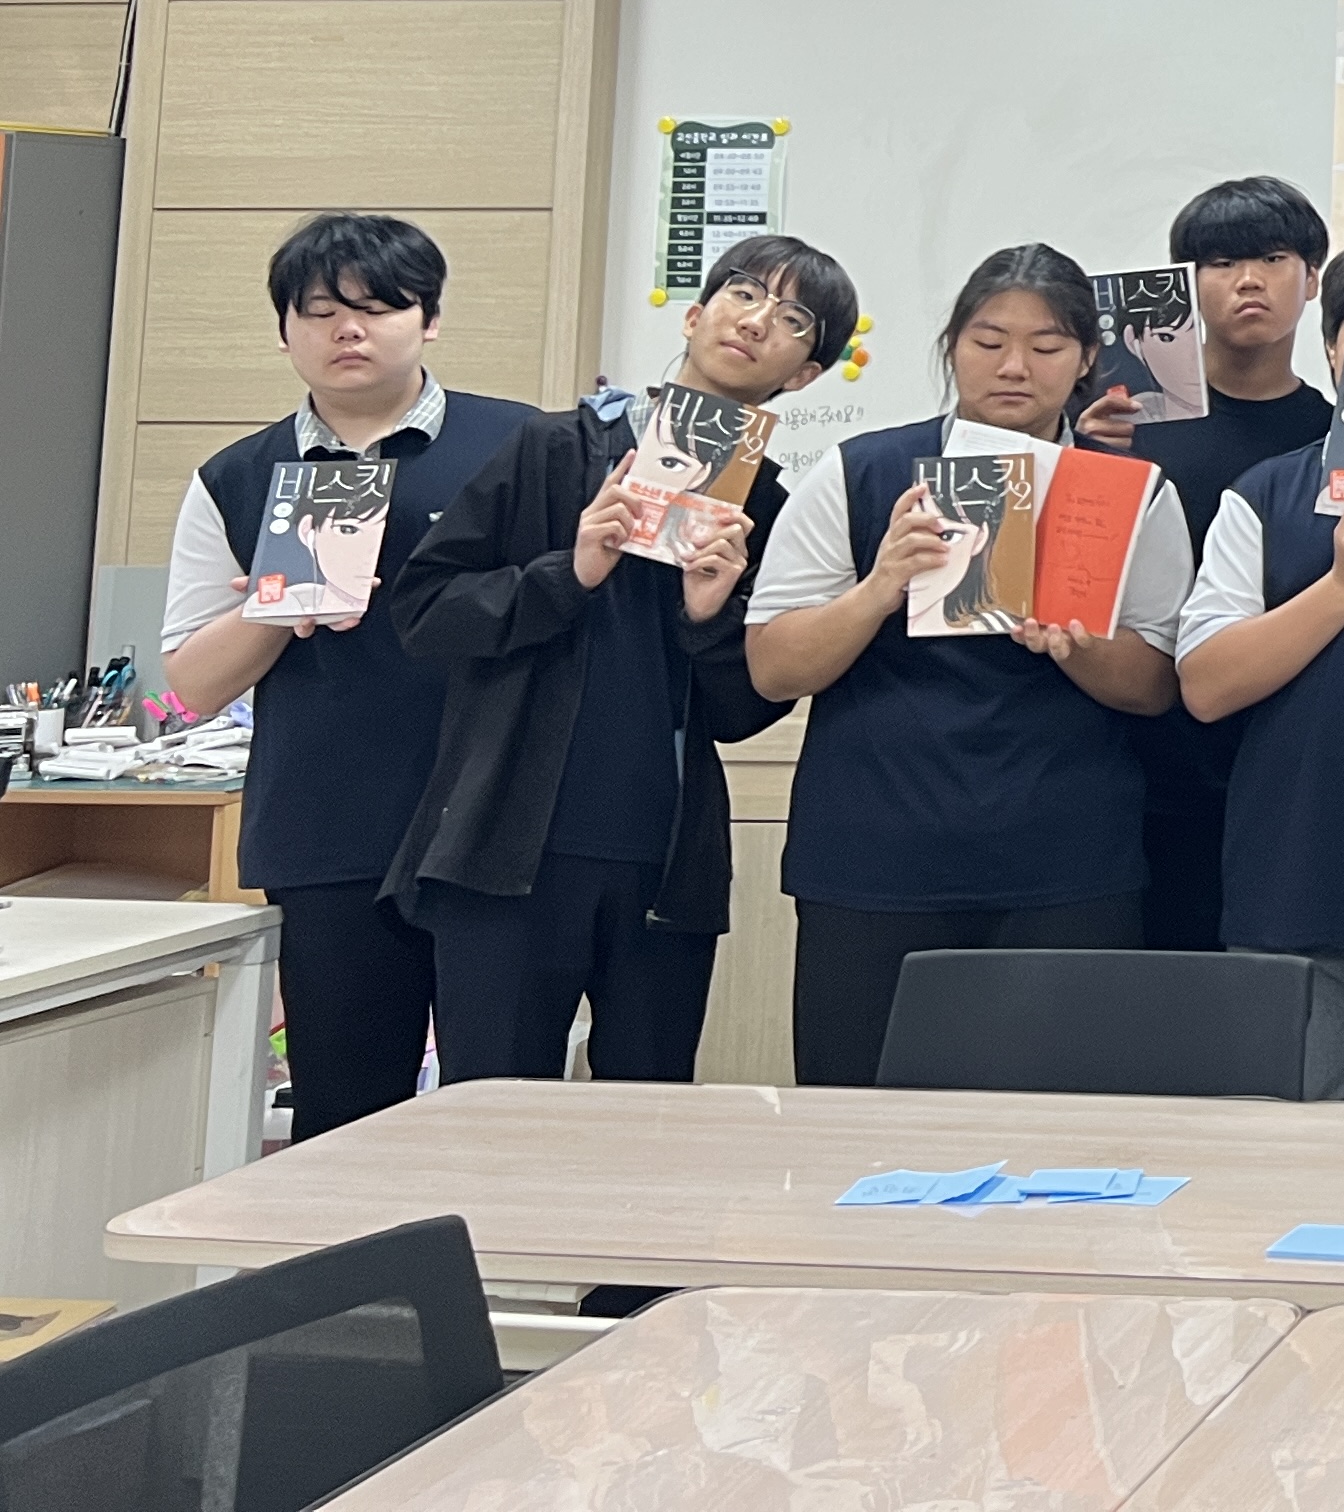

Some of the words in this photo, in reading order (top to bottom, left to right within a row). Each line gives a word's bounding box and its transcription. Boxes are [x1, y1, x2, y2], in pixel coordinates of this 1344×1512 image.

[1092, 270, 1188, 313] 비스킷
[659, 387, 768, 451] 비스킷
[275, 463, 392, 504] 비스킷
[917, 457, 1026, 507] 비스킷
